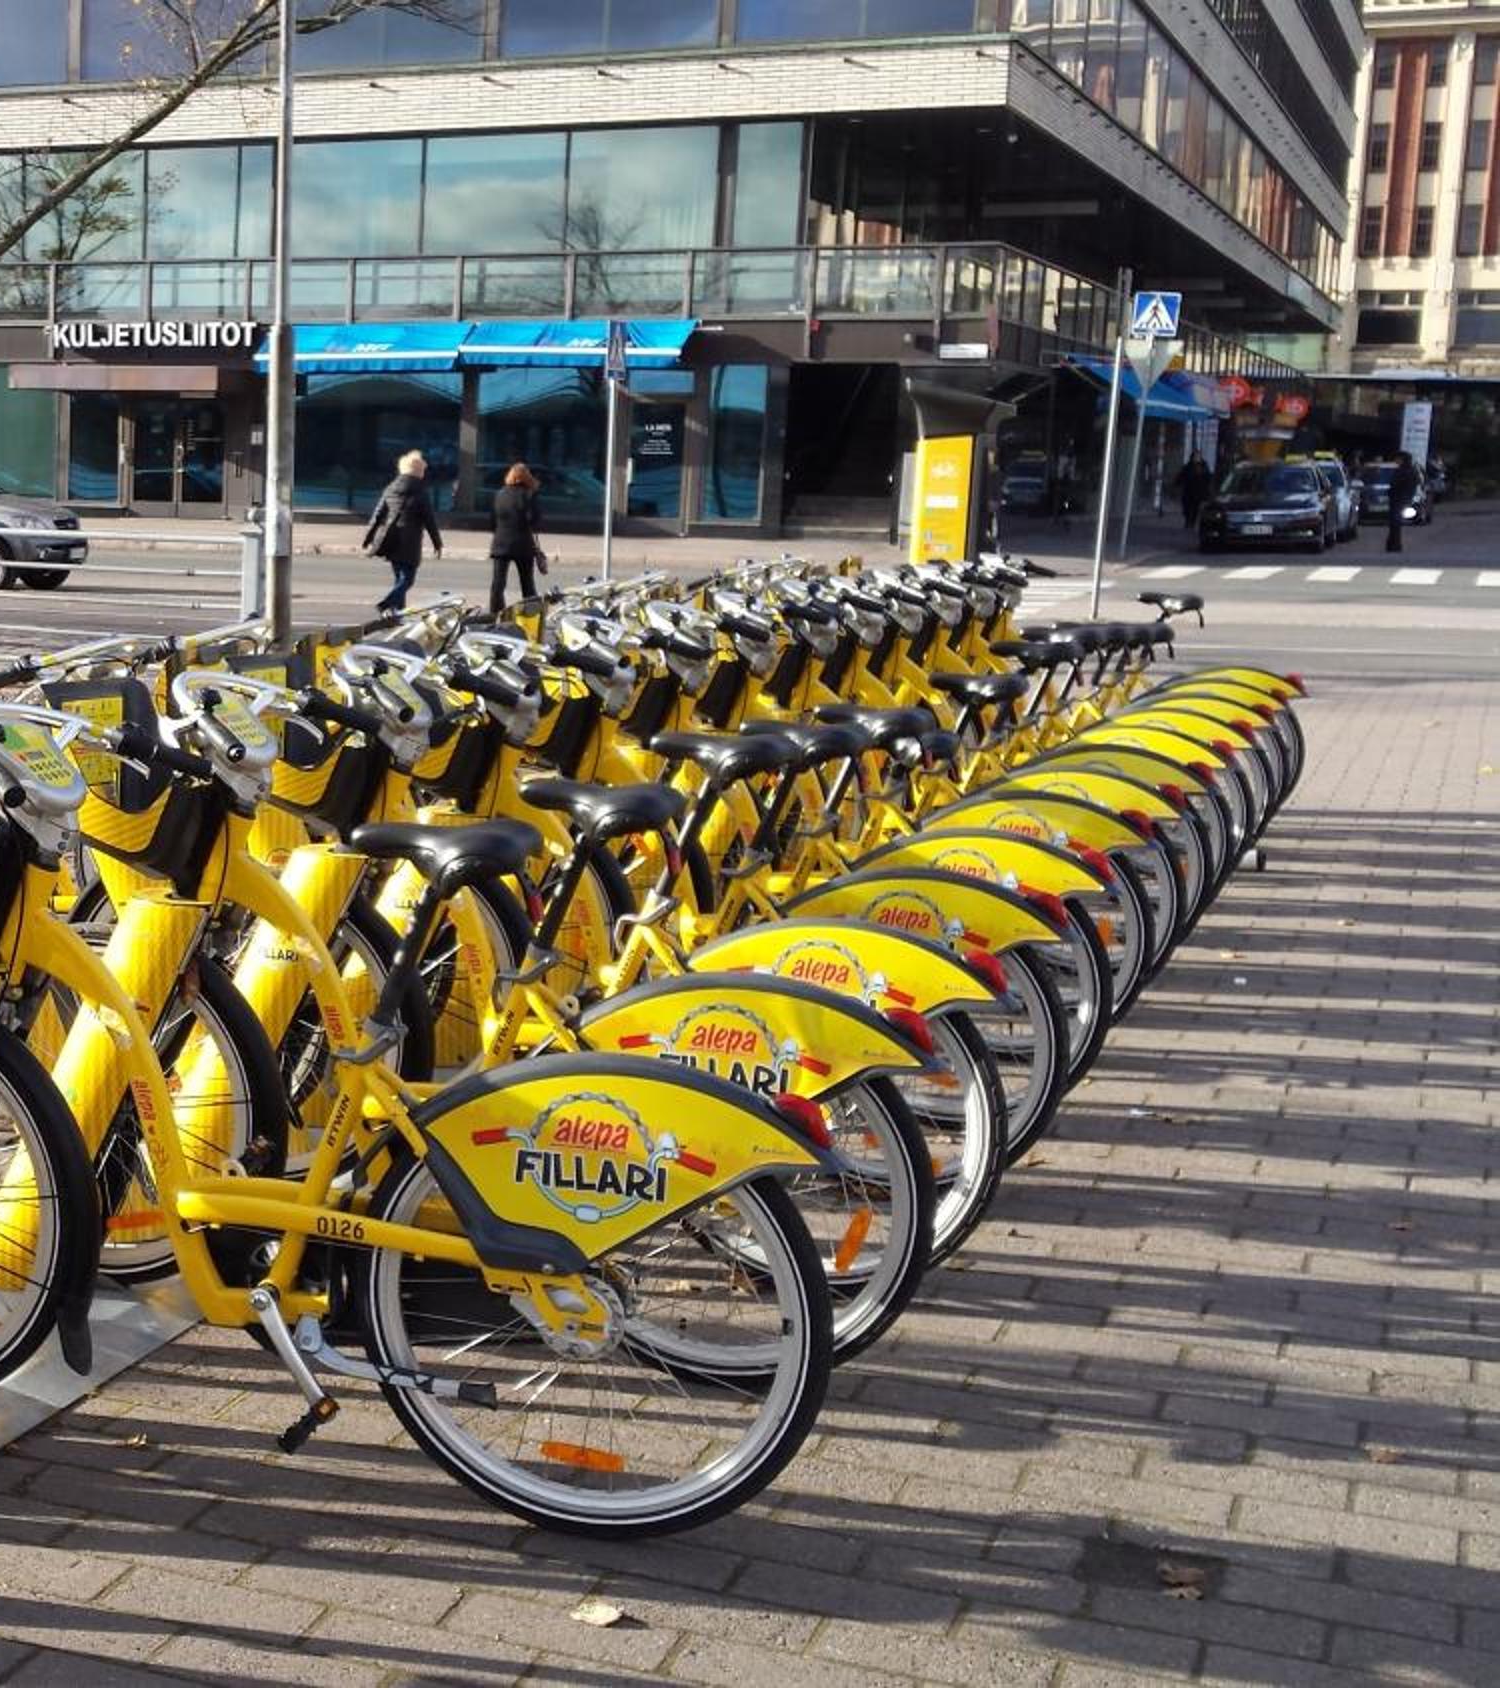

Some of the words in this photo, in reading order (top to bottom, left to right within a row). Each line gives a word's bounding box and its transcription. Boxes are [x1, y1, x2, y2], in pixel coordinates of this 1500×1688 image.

[53, 321, 257, 347] KULJETUSLIITOT
[877, 905, 933, 930] alepa
[791, 957, 850, 986] alepa
[691, 1023, 757, 1054] alepa
[660, 1053, 788, 1096] LARI
[553, 1114, 631, 1152] alepa
[514, 1149, 667, 1203] FILLARI
[316, 1215, 366, 1239] 0126
